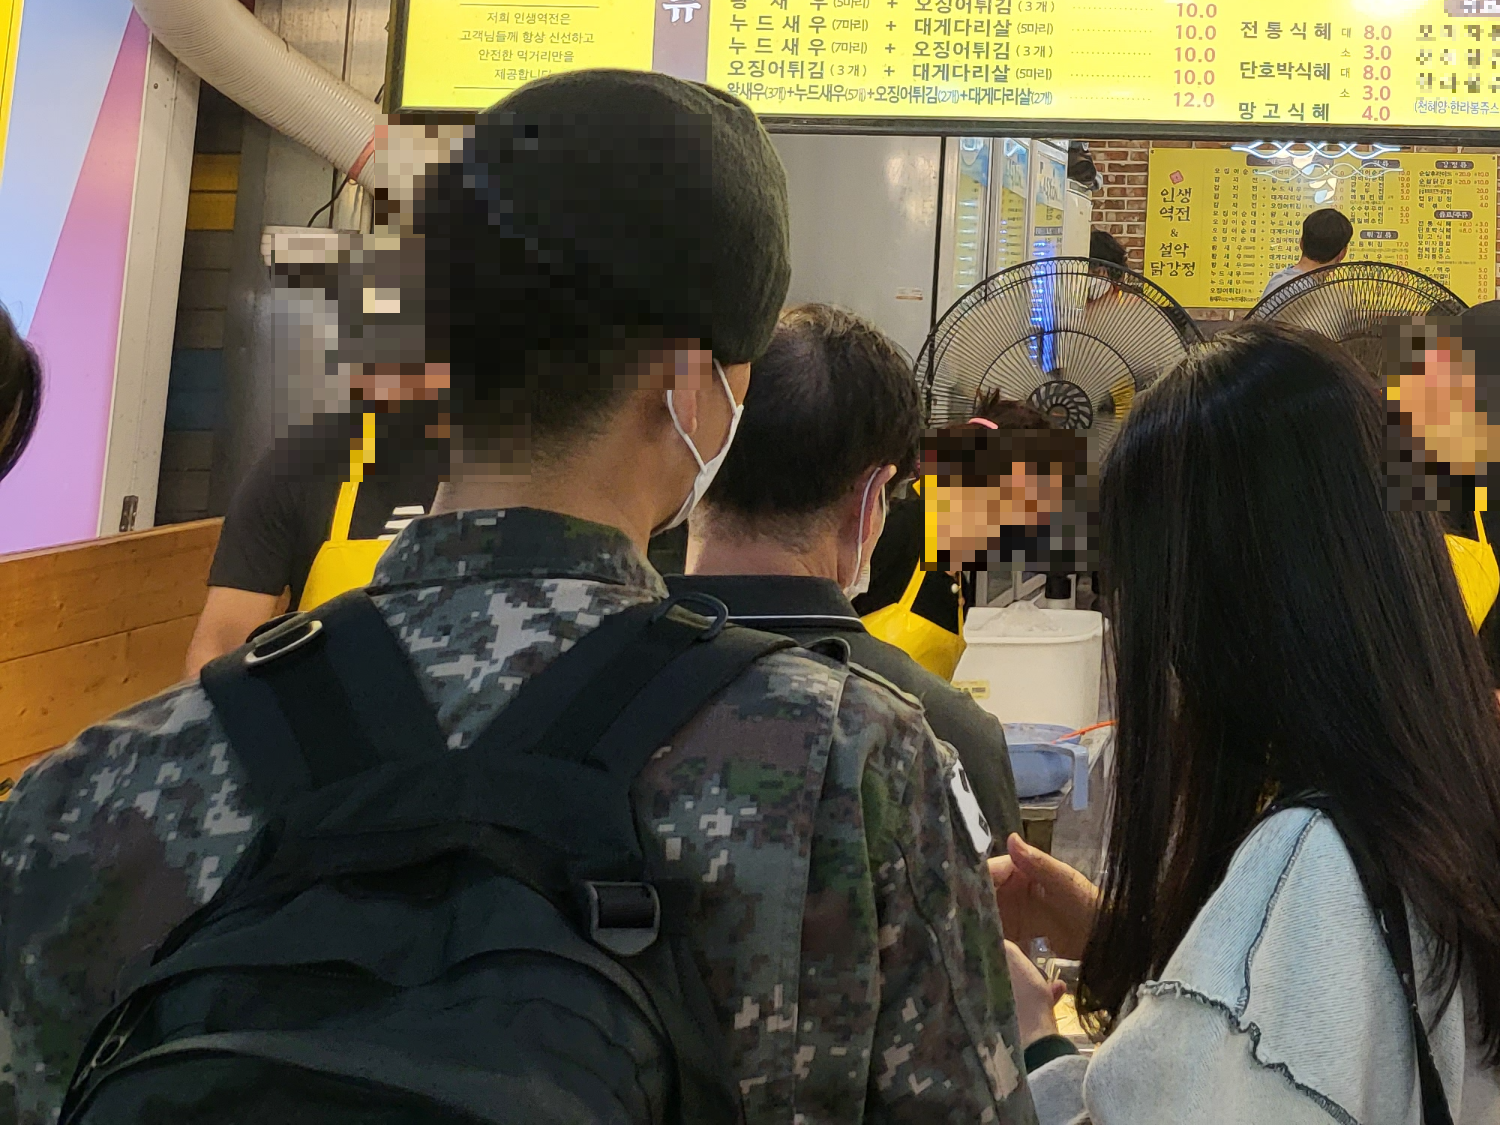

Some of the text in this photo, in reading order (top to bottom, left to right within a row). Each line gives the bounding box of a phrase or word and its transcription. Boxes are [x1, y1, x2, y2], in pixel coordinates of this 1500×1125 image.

[487, 12, 571, 25] 저희 인생역전은
[1177, 3, 1217, 18] 10.0
[730, 14, 827, 34] 누드새우
[915, 18, 1012, 37] 대게다리살
[1176, 25, 1216, 40] 10.0
[1241, 21, 1392, 40] 전통식혜 대 8.0
[460, 30, 594, 44] 고객님들께 항상 신선하고
[479, 49, 574, 62] 안전한 먹거리만을
[729, 37, 826, 56] 누드새우
[913, 41, 1009, 60] 오징어튀김
[1175, 47, 1215, 62] 10.0
[1341, 45, 1391, 60] 소 3.0
[728, 60, 824, 79] 오징어튀김
[913, 63, 1010, 83] 대게다리살
[1174, 70, 1215, 85] 10.0
[1240, 61, 1391, 80] 단호박식혜 대 8.0
[1174, 92, 1214, 107] 12.0
[1339, 85, 1391, 101] 소 3.0
[1239, 102, 1390, 120] 망고식혜 4.0
[1160, 187, 1192, 204] 인생
[1159, 205, 1191, 223] 역전
[1170, 228, 1179, 238] &
[1159, 242, 1190, 258] 설악
[1150, 260, 1196, 277] 닭강정
